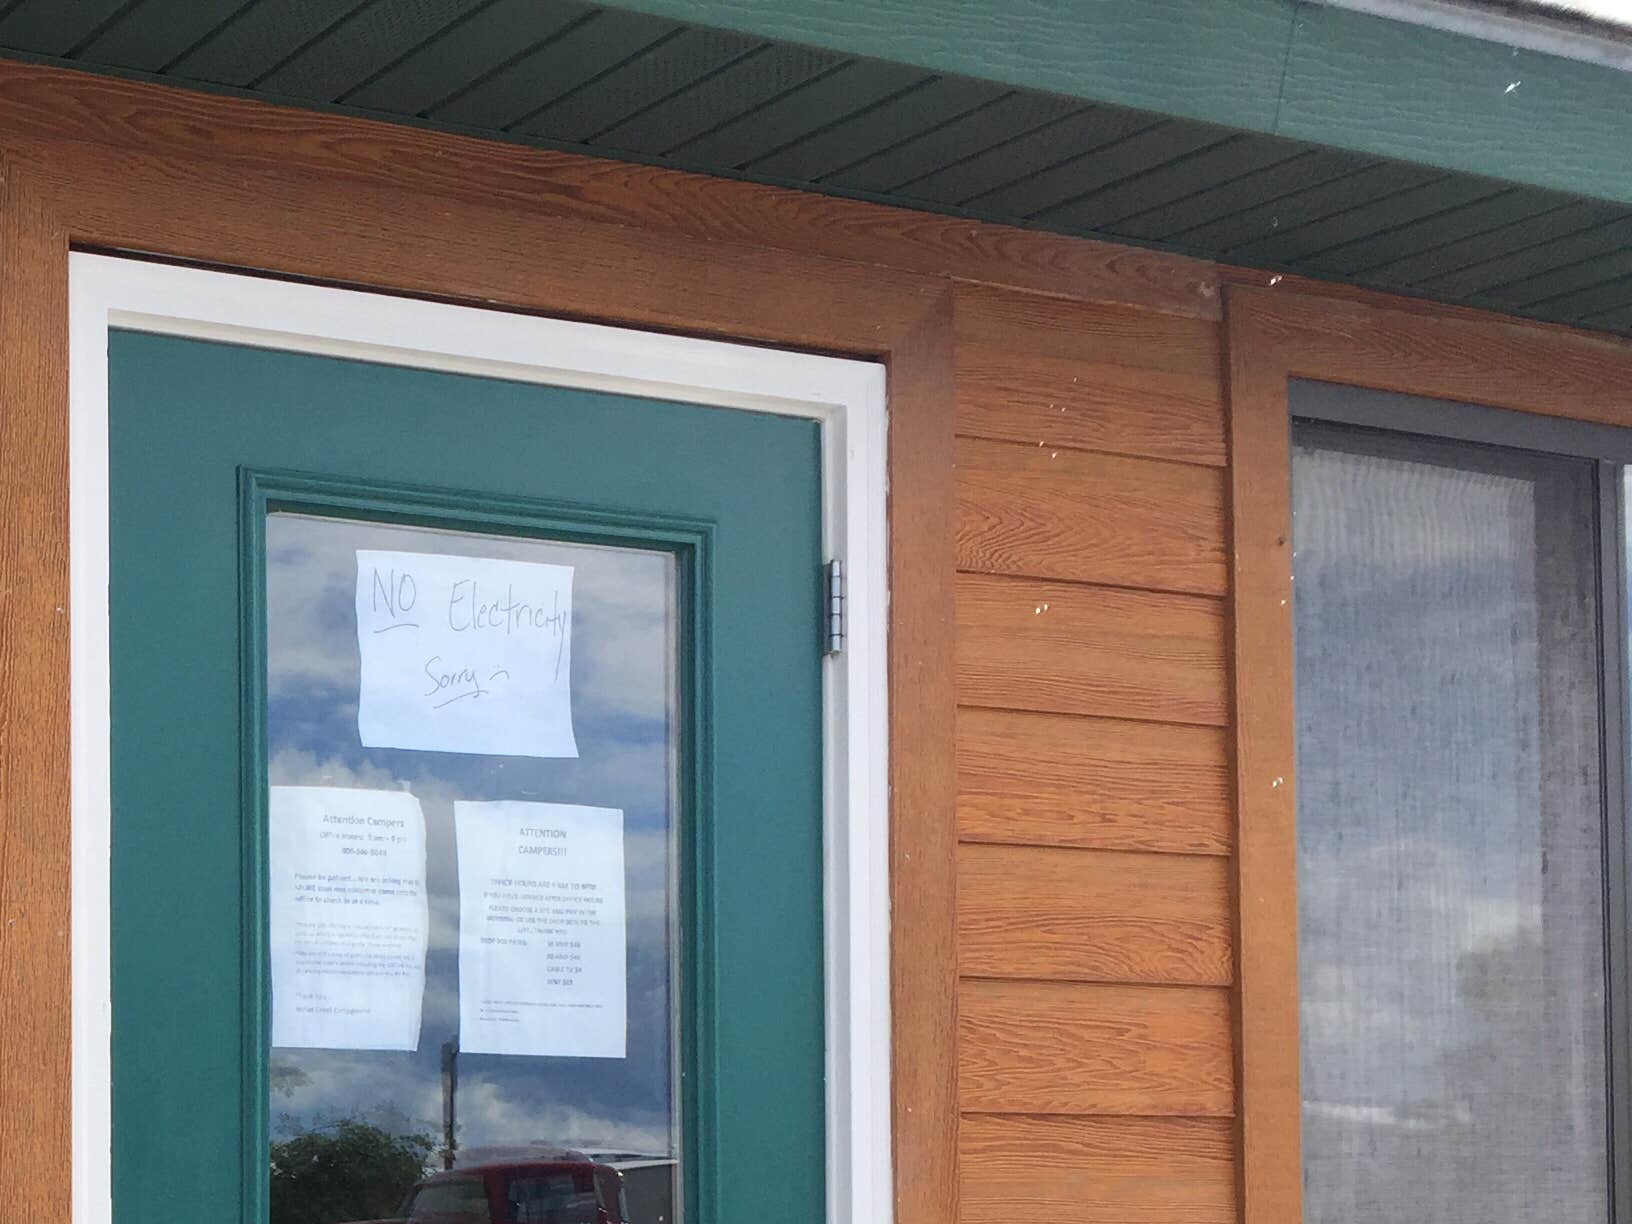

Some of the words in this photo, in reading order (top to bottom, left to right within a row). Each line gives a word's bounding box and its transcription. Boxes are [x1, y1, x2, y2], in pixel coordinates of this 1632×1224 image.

[373, 567, 417, 618] NO
[424, 656, 479, 699] Sorry
[519, 827, 567, 839] ATTENTION
